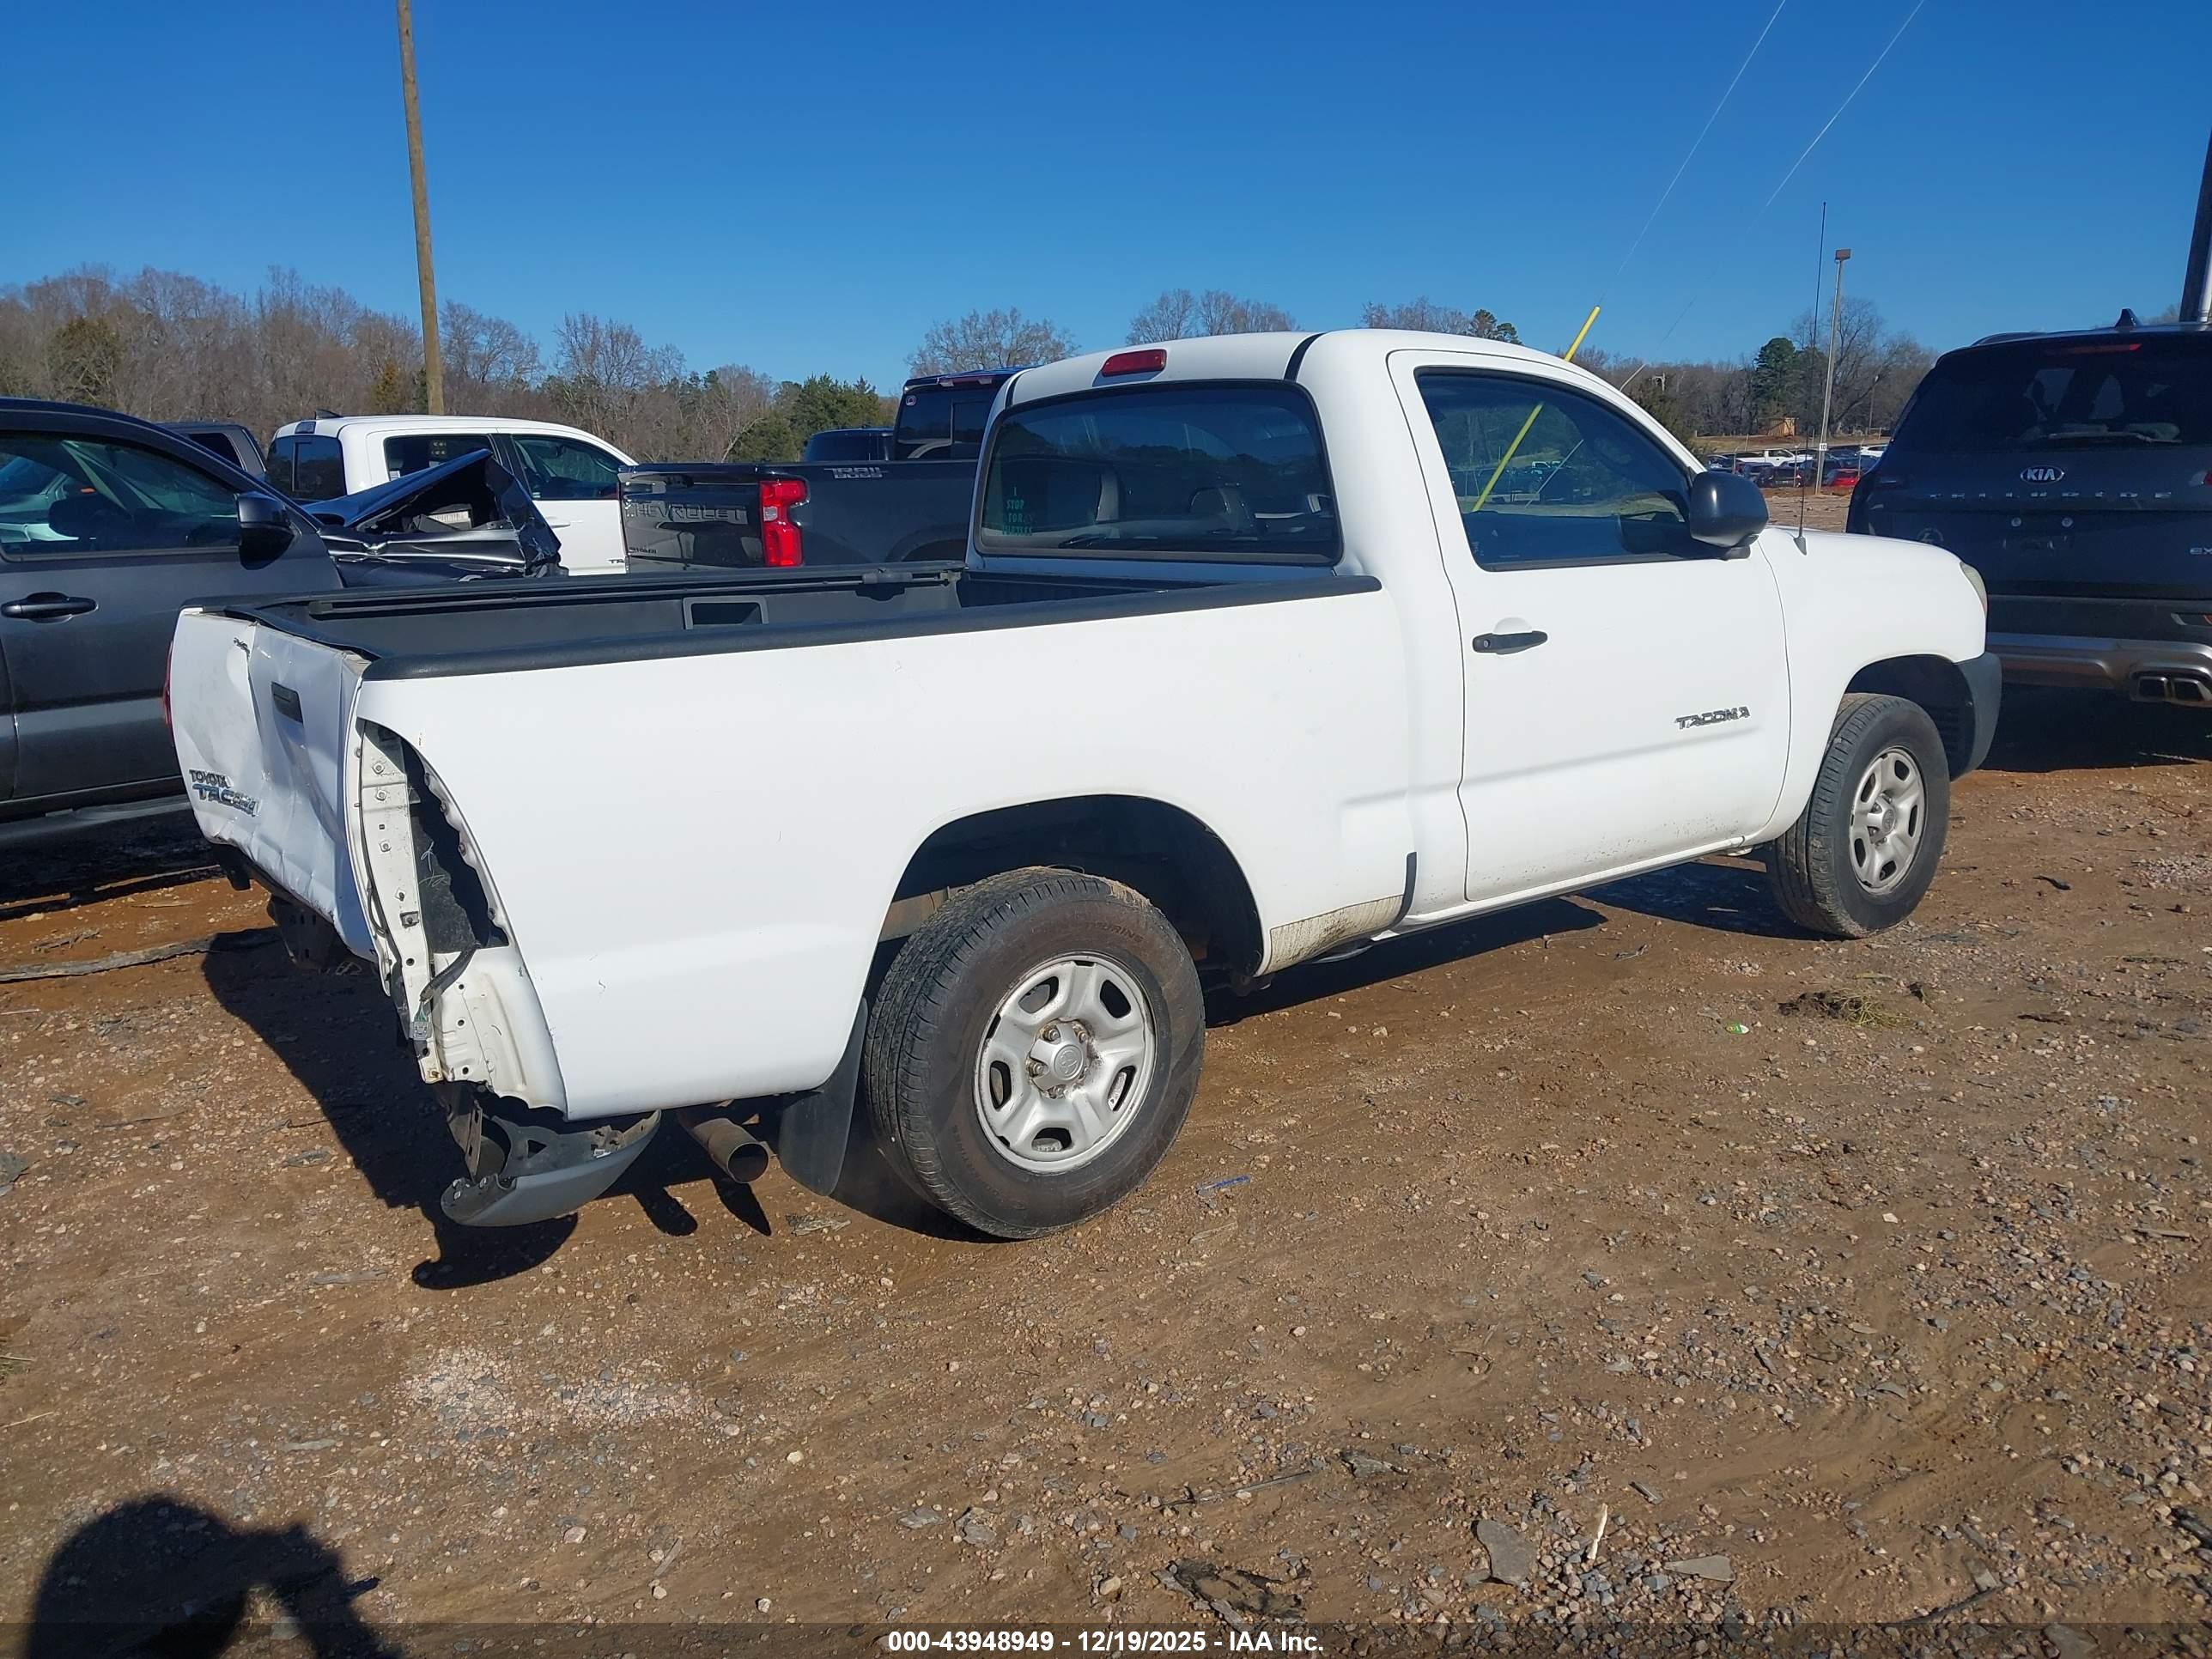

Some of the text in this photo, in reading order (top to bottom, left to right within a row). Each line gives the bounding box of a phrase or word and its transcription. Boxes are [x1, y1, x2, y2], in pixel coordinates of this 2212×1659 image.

[2027, 468, 2056, 481] KIA
[1006, 499, 1024, 509] STOP
[1674, 706, 1751, 730] TACOMA
[189, 769, 232, 789] TOYOTA
